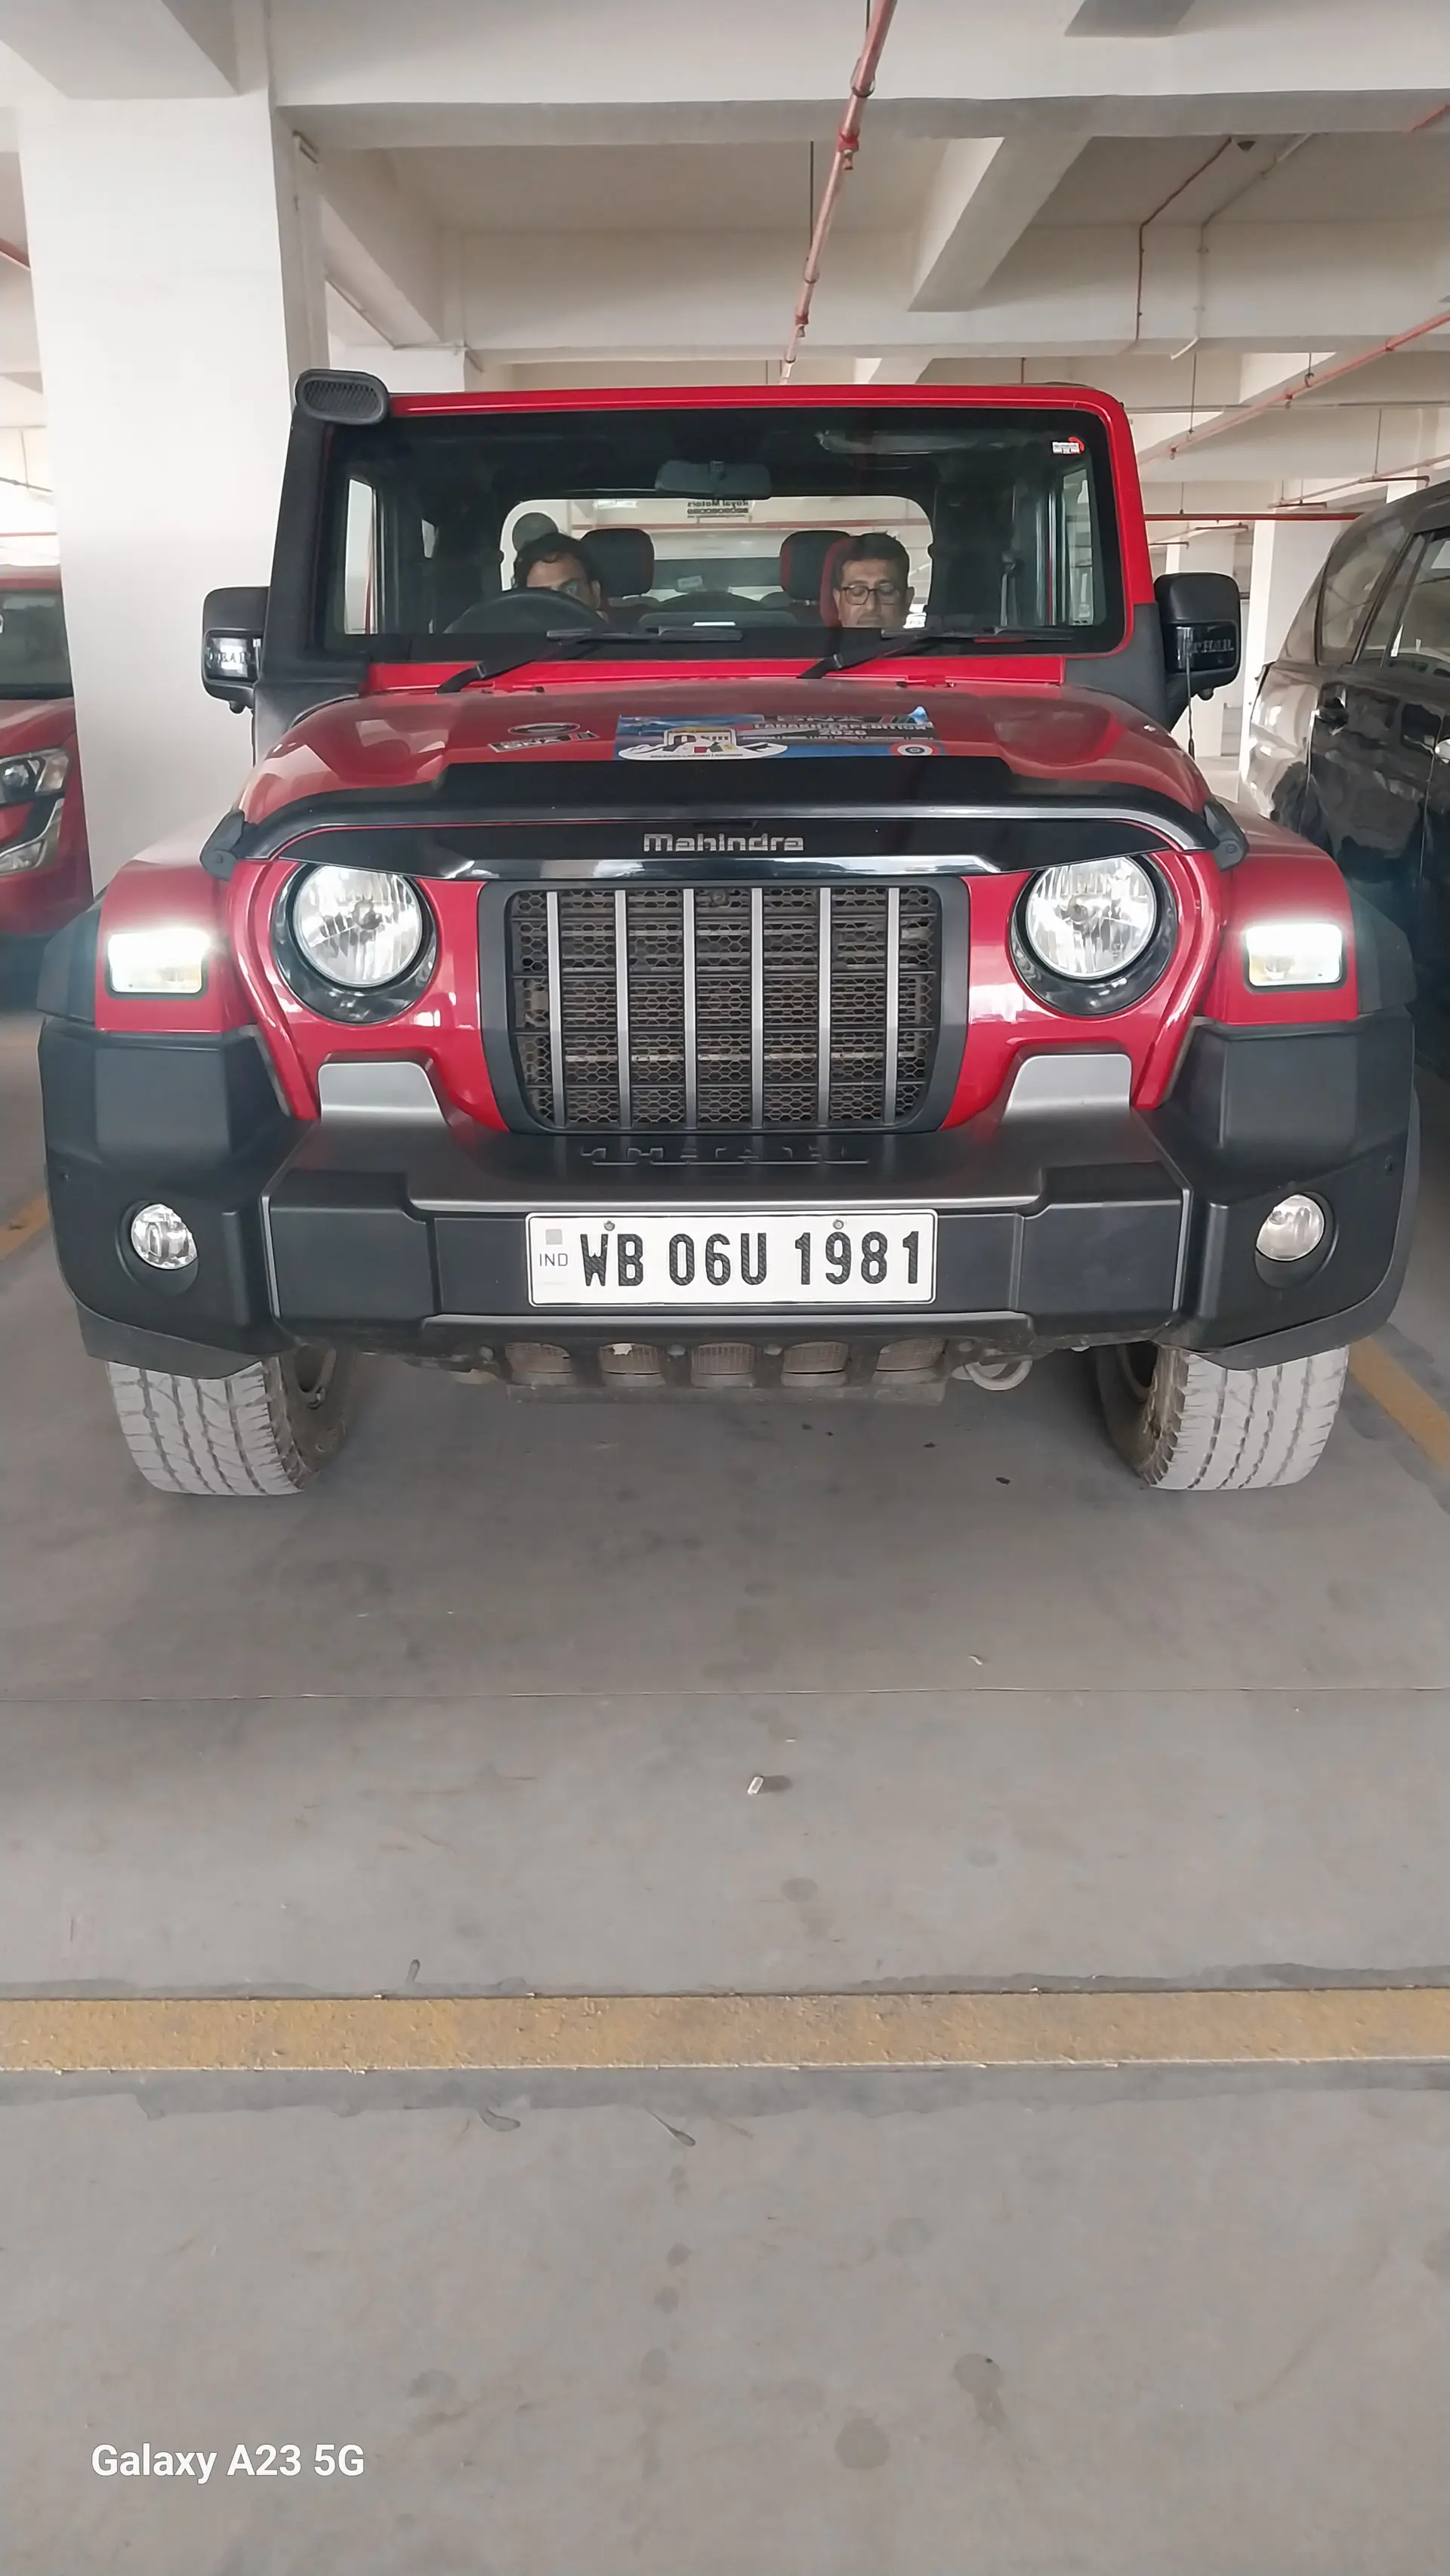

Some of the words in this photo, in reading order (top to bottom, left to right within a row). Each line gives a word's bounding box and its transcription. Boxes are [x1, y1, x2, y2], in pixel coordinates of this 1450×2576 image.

[539, 1253, 568, 1267] IND
[580, 1233, 643, 1286] WB
[669, 1232, 767, 1286] 06U
[795, 1231, 920, 1285] 1981
